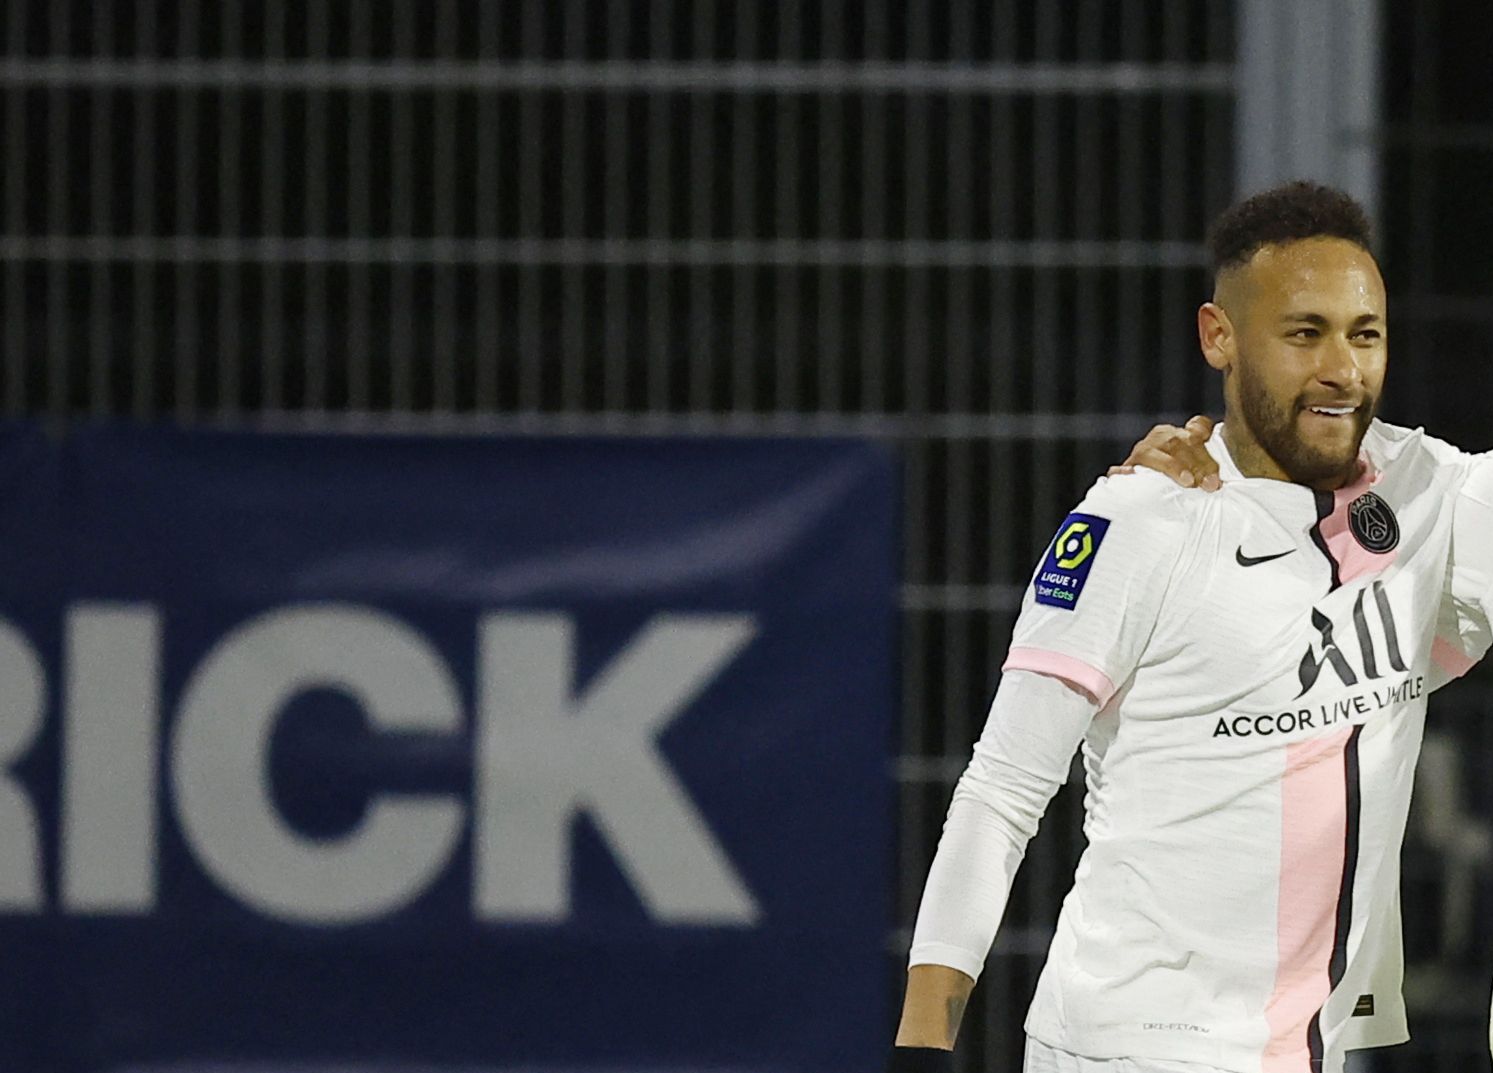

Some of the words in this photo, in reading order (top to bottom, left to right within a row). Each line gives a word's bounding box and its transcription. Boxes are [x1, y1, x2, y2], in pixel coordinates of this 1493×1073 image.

[1040, 572, 1071, 586] LIGUE
[1071, 579, 1078, 588] 1
[1212, 709, 1316, 738] ACCOR
[1321, 696, 1371, 726] LIVE
[0, 602, 760, 926] ICK
